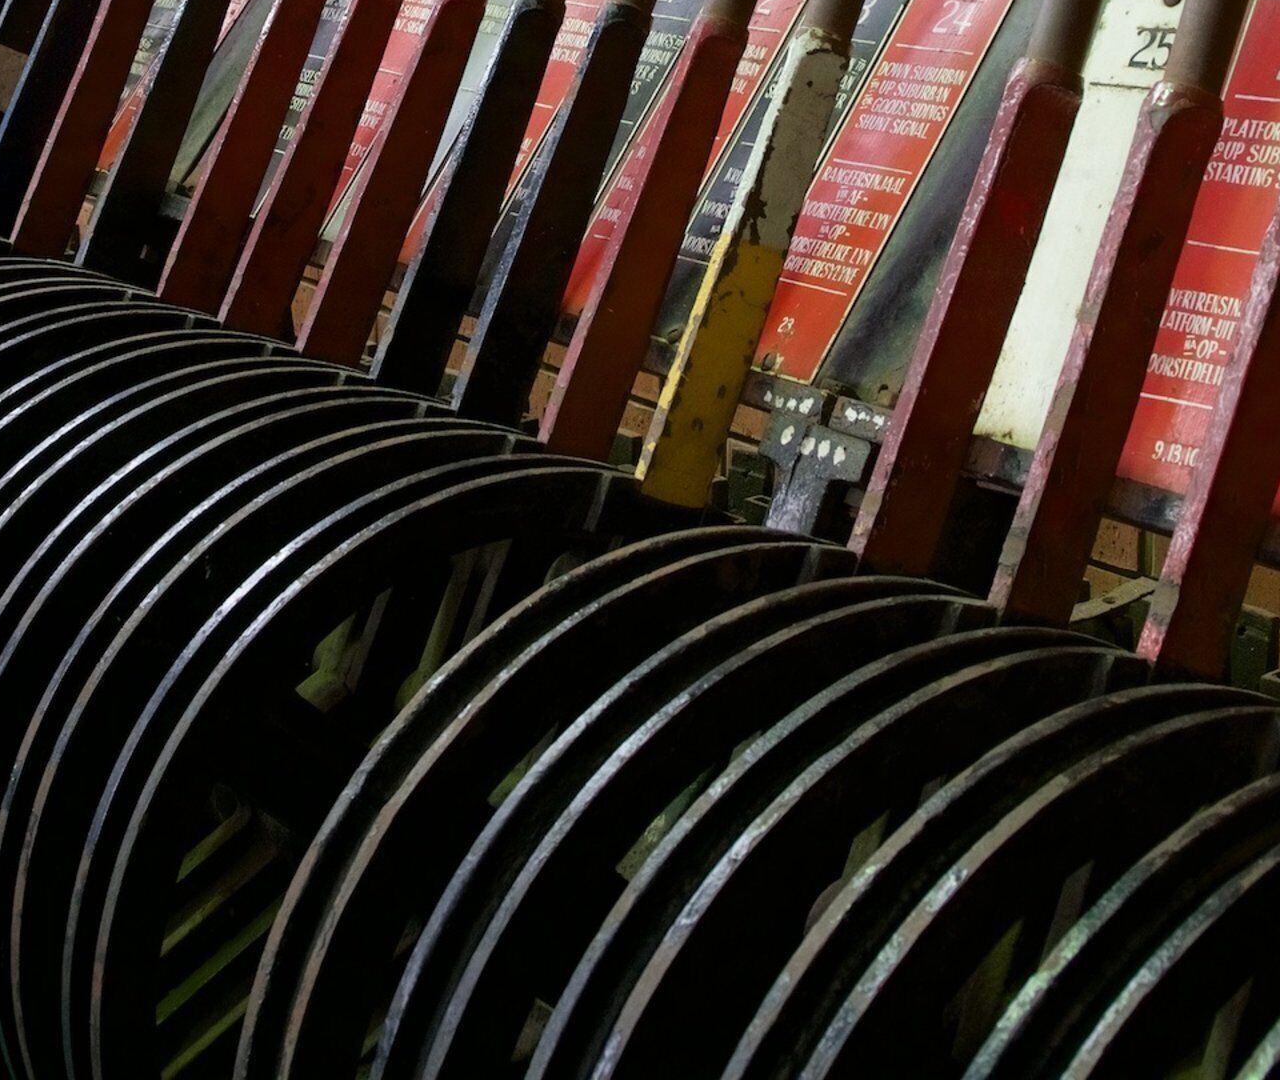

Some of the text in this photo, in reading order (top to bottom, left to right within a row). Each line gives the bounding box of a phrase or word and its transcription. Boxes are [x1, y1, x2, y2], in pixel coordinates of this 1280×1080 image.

[932, 0, 976, 35] 24
[1128, 27, 1173, 70] 25
[877, 61, 968, 85] DOWN SUBURBAN
[879, 80, 896, 95] UP
[894, 82, 951, 103] SUBURBAN
[871, 98, 910, 116] GOODS
[907, 101, 950, 121] SIDINGS
[855, 114, 930, 139] SHUNT SIGNAL
[1223, 141, 1245, 161] UP
[1203, 162, 1275, 187] STARTING
[868, 211, 891, 231] LYN
[849, 248, 872, 266] LYN
[1159, 310, 1237, 341] LATFORM-UIT
